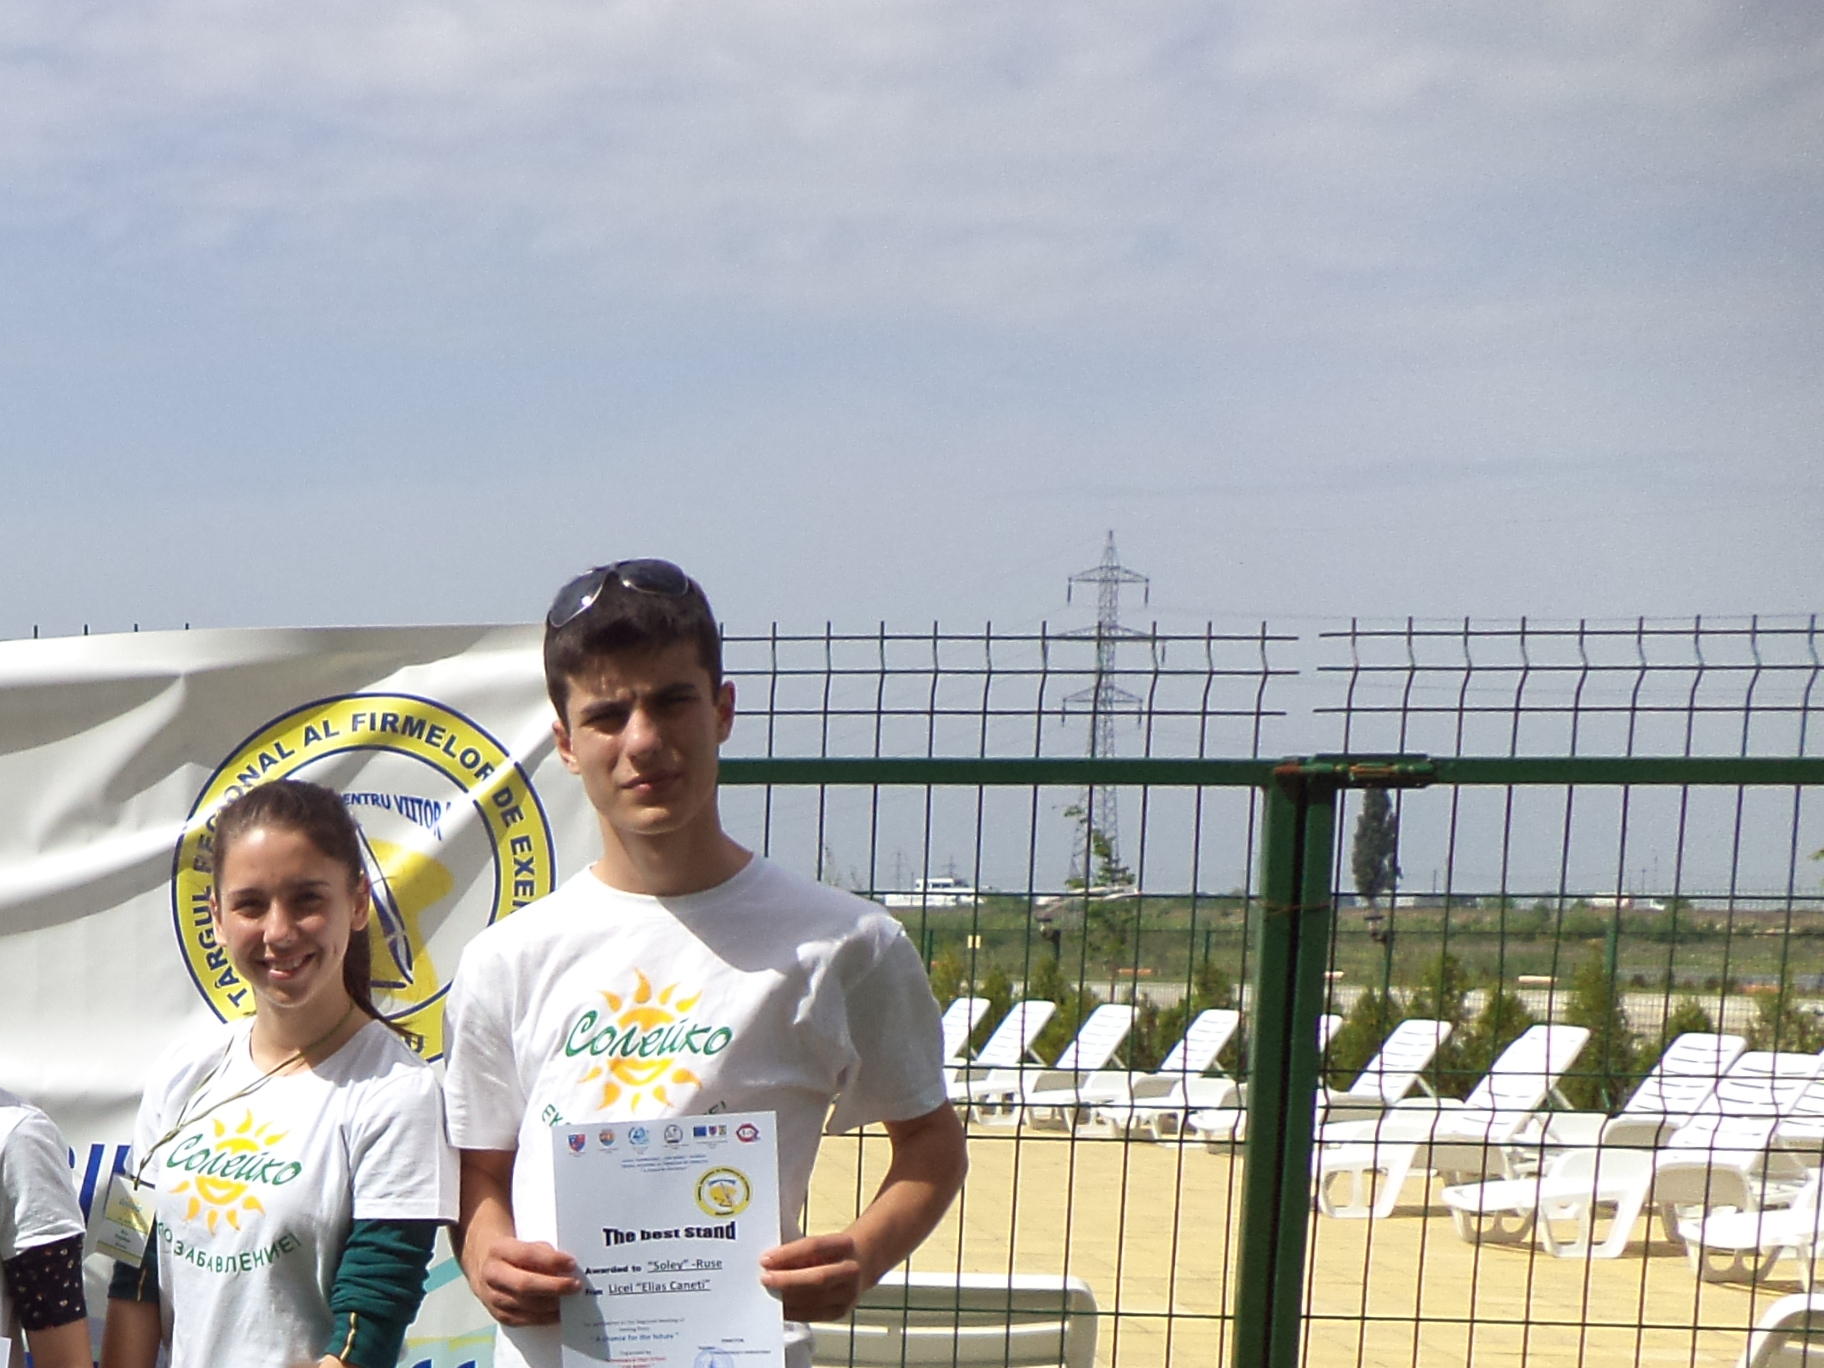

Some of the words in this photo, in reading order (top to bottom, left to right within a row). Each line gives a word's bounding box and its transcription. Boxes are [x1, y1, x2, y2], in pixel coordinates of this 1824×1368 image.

[303, 720, 340, 747] AL
[352, 712, 495, 783] FIRMELOR
[492, 786, 524, 828] DE
[510, 835, 535, 912] EXE
[339, 793, 391, 810] ENTRU
[565, 1010, 732, 1057] Солейко
[166, 1133, 302, 1185] Солейко
[603, 1227, 636, 1247] The
[640, 1228, 681, 1241] best
